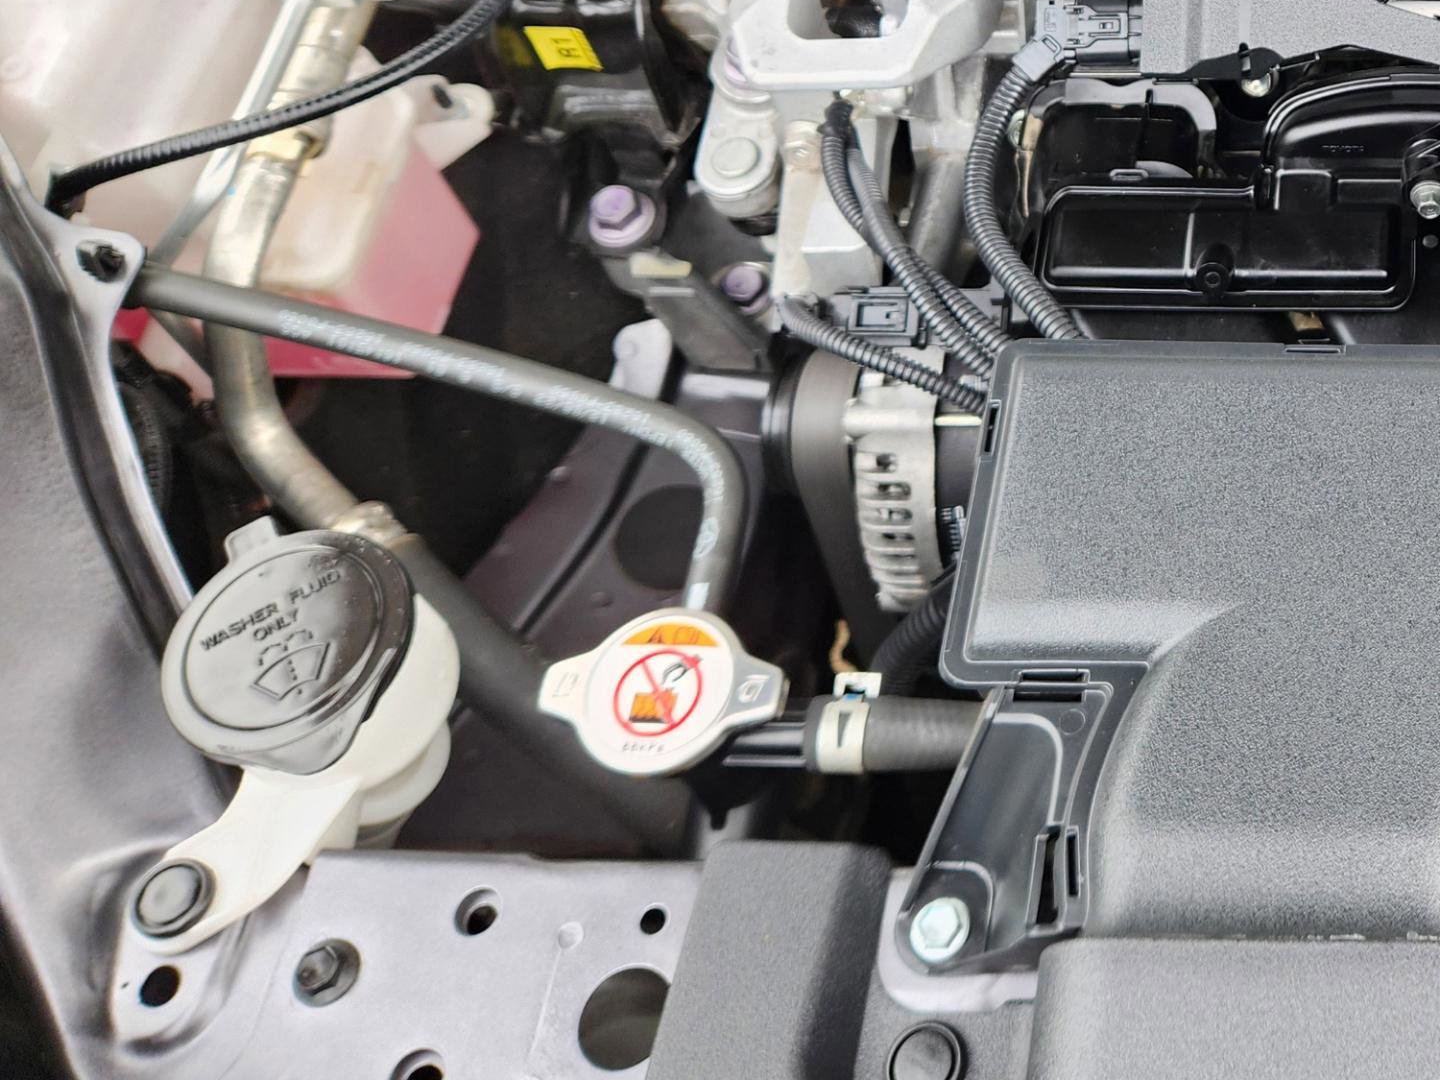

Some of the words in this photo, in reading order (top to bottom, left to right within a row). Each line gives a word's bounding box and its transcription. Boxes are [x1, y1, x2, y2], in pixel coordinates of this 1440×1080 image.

[200, 602, 279, 651] WASHER
[290, 571, 342, 605] FLUID
[252, 608, 299, 642] ONLY
